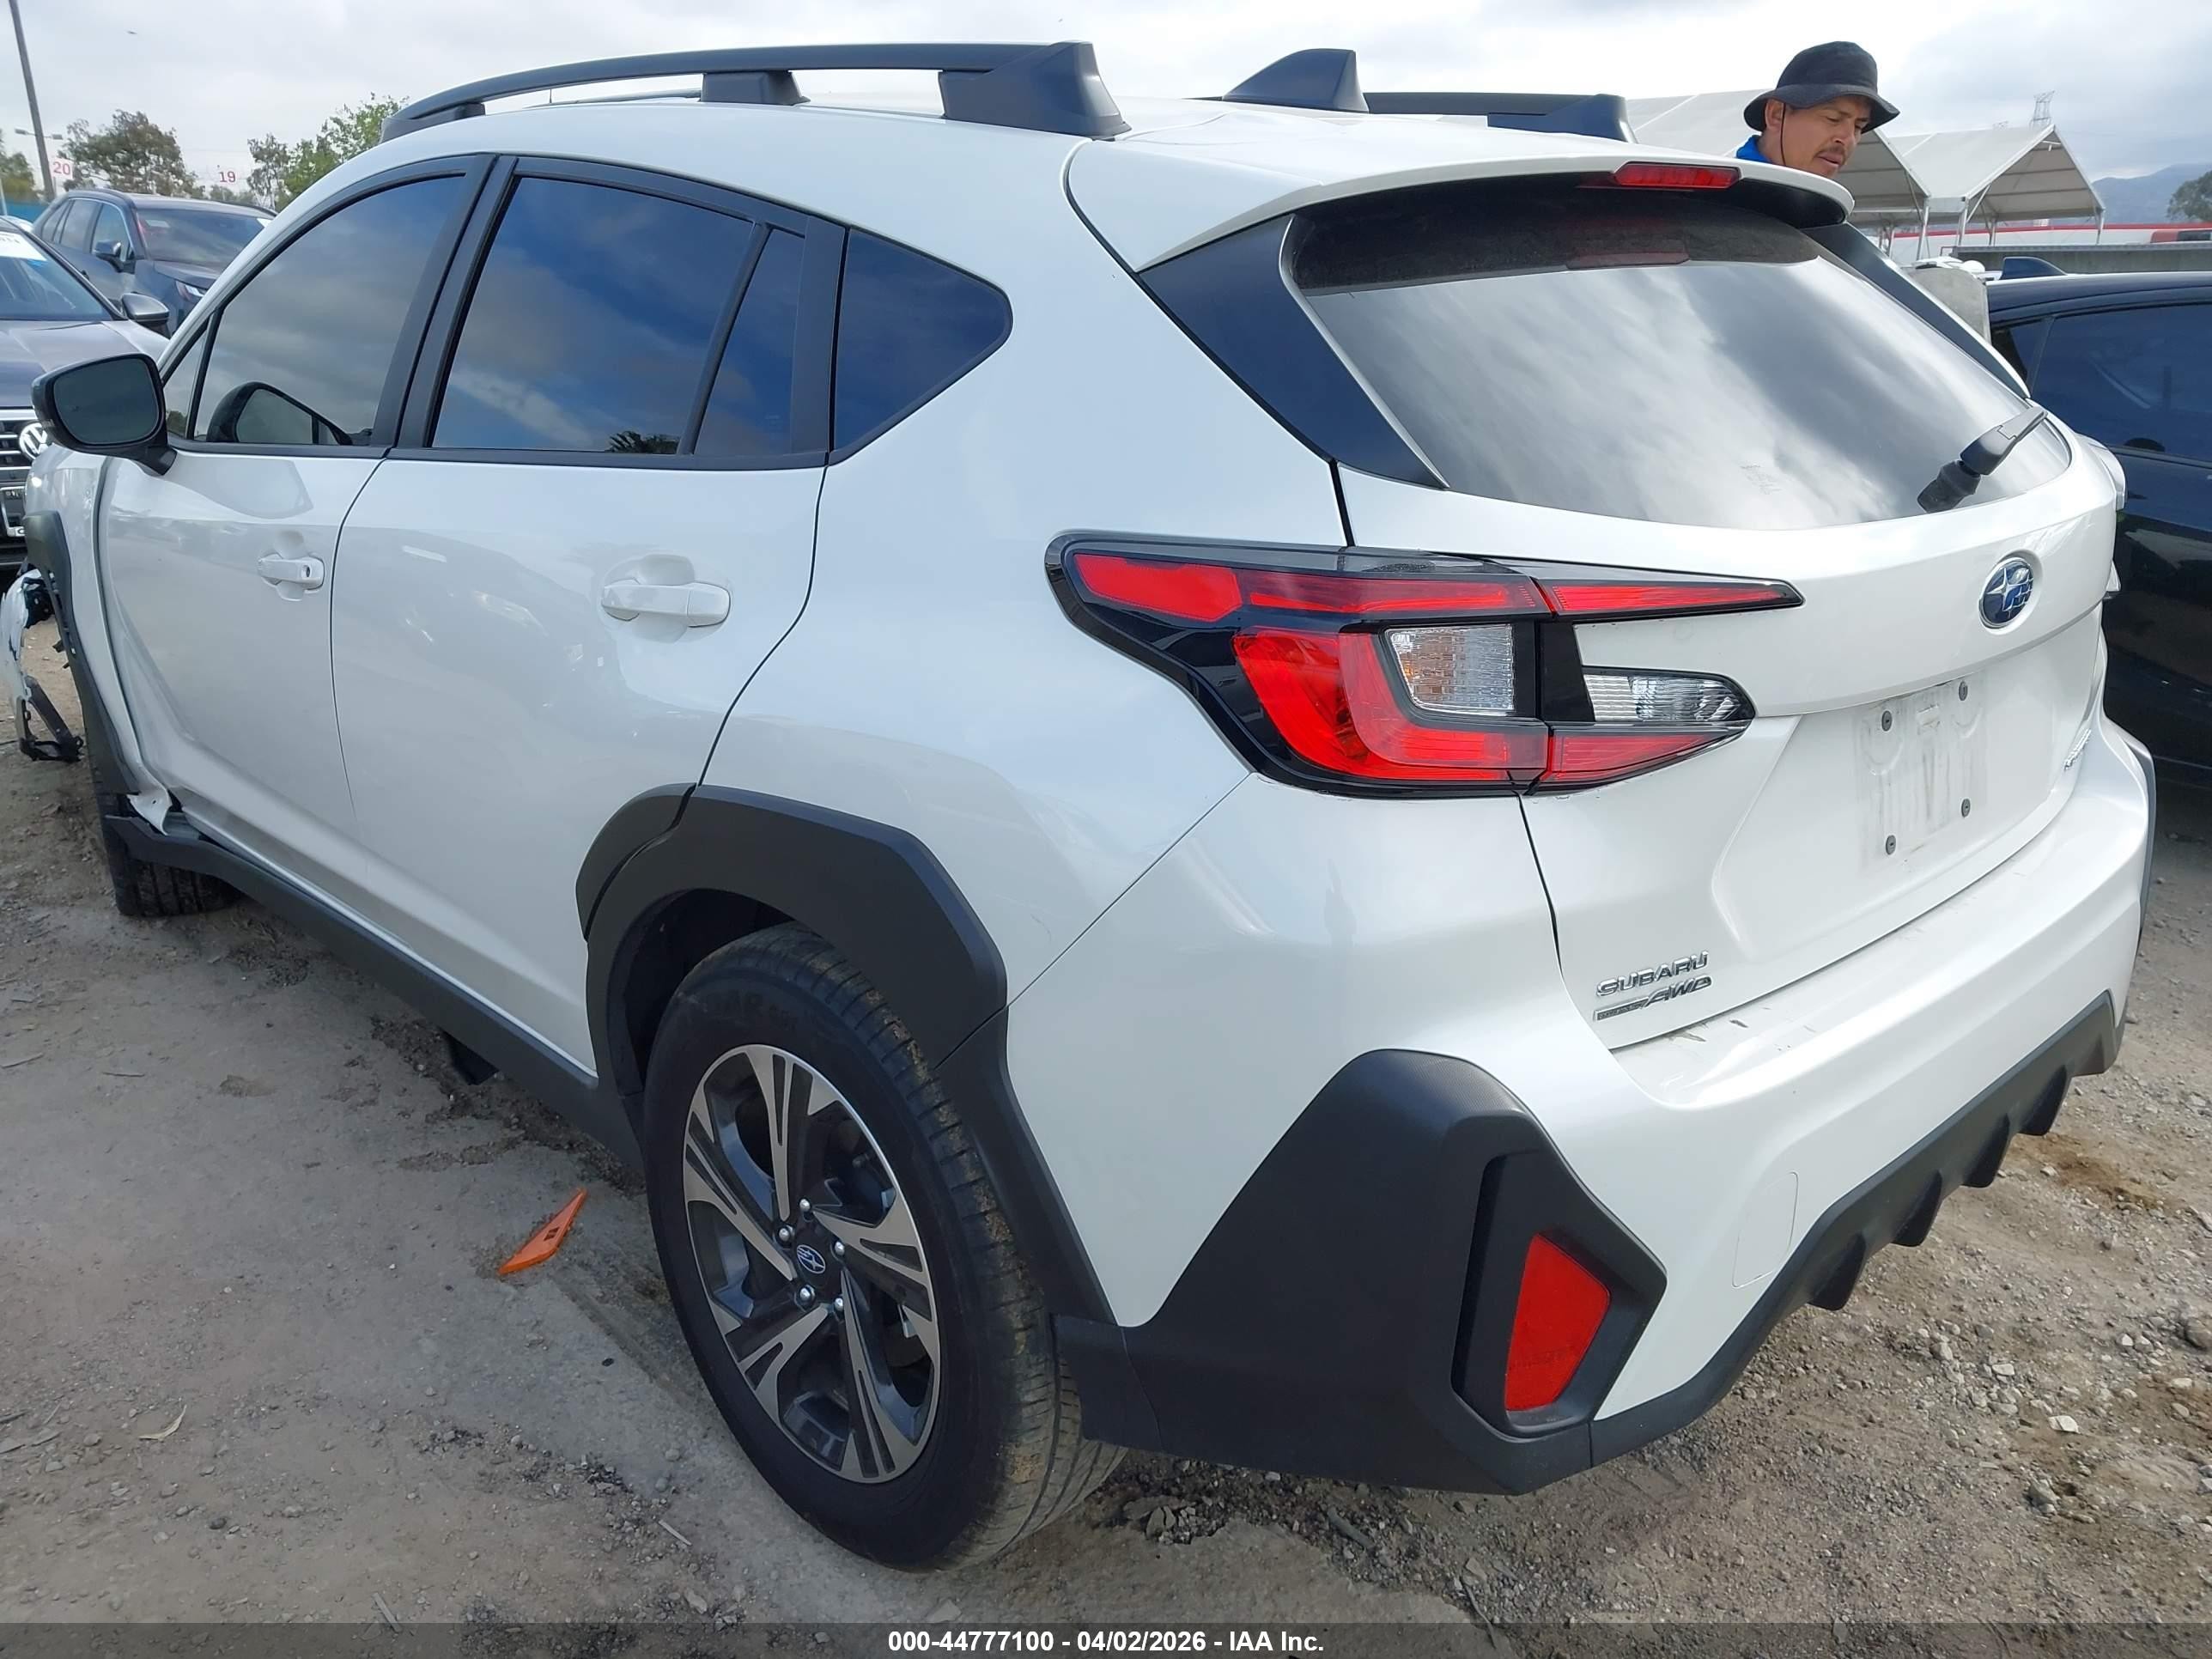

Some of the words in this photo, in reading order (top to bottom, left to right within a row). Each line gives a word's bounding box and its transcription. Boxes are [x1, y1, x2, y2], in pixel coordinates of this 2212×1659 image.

[52, 161, 71, 175] 20
[219, 171, 236, 183] 19
[1596, 951, 1709, 997] SUBARU
[1644, 975, 1713, 1008] AWD
